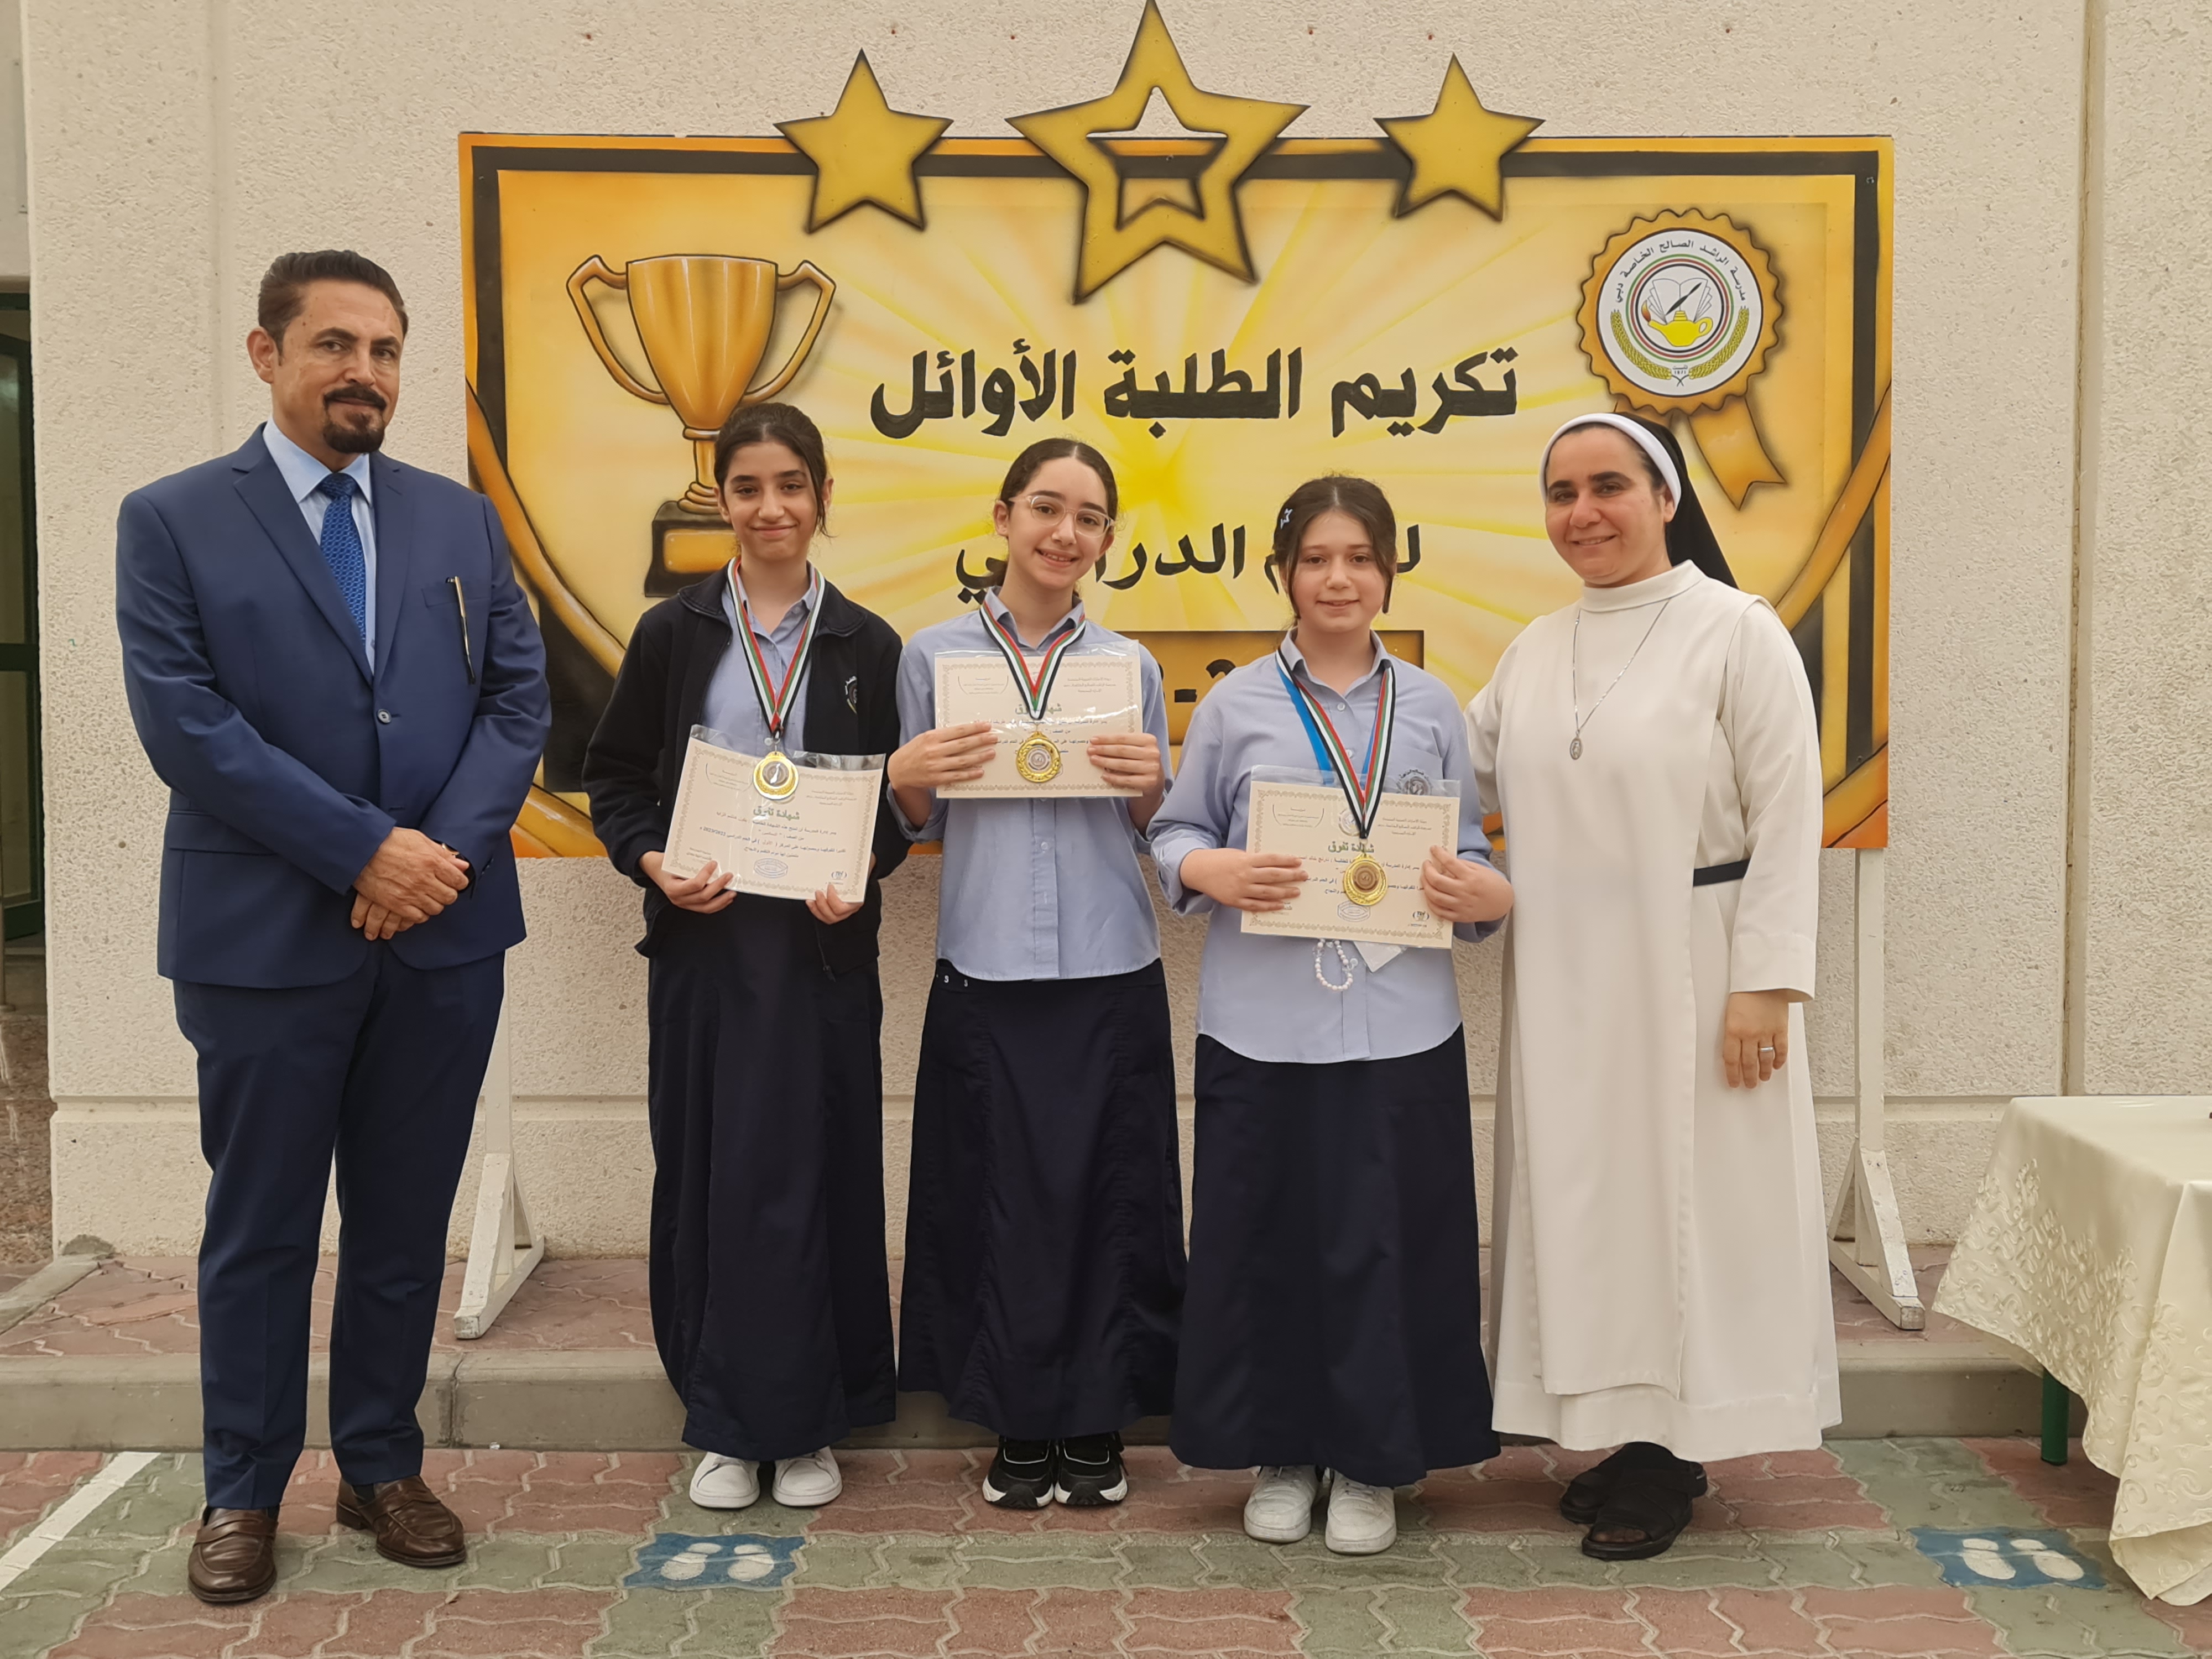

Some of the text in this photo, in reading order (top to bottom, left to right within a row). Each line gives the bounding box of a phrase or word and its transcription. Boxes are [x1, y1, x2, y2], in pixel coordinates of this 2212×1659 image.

[1659, 239, 1694, 253] الصالح
[1699, 244, 1729, 265] الراشد
[1620, 247, 1654, 278] الخاصة
[1730, 266, 1746, 301] مدرسة
[870, 338, 1518, 439] تكريم الطلبة الأوائل
[956, 523, 1246, 604] الدراي
[776, 810, 800, 821] شهادة
[1328, 841, 1374, 853] شادة تفوق
